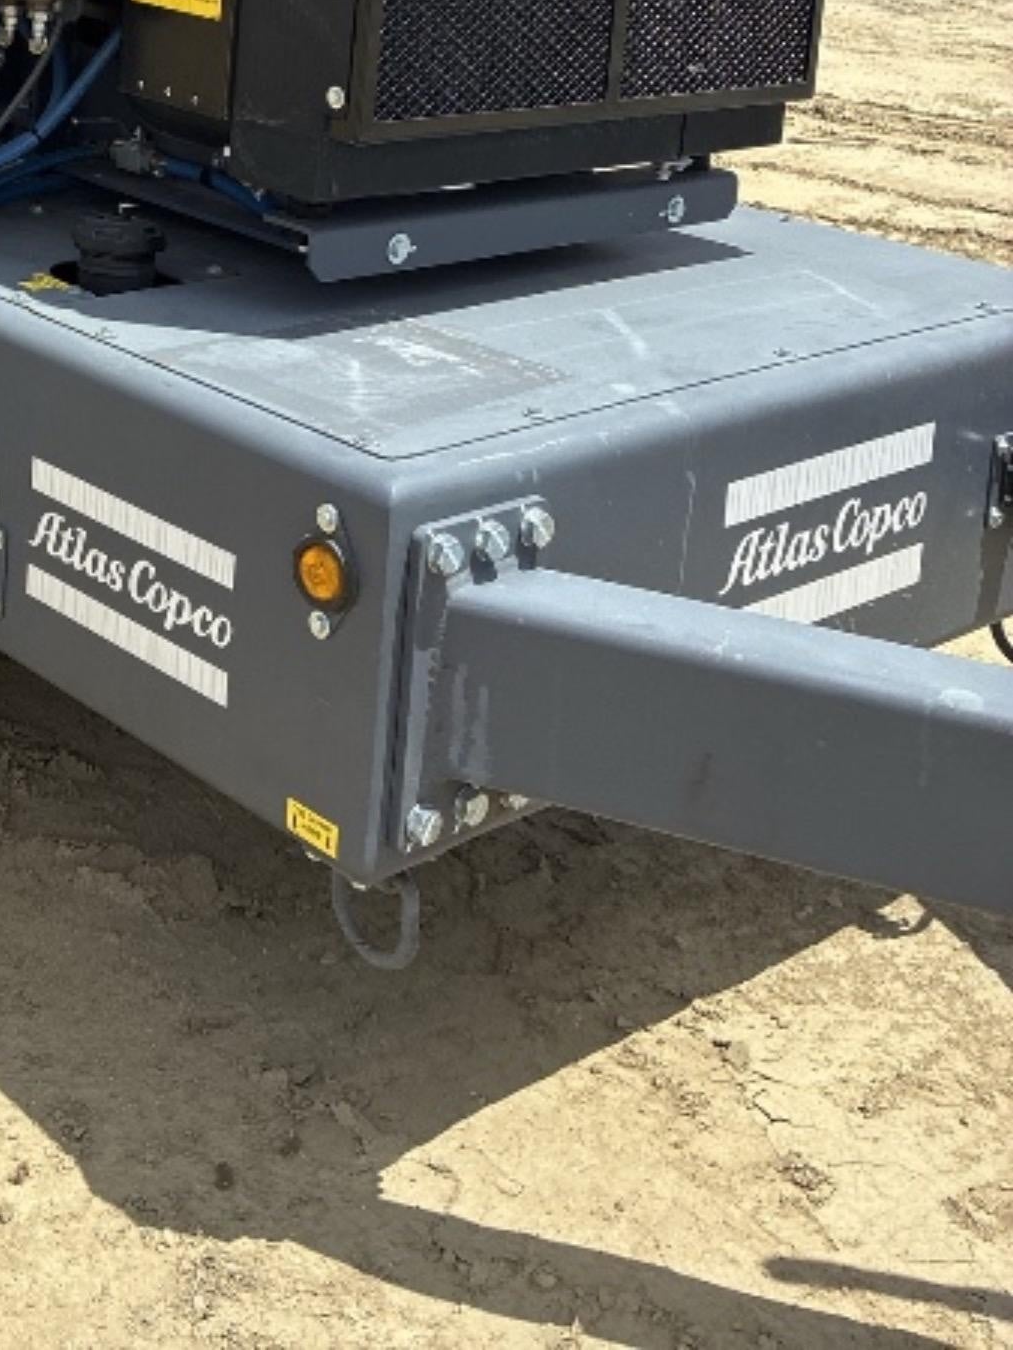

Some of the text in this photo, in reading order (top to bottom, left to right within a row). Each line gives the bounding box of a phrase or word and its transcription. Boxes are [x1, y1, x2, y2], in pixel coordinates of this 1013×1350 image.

[27, 511, 233, 649] Atlas Copco
[717, 490, 928, 597] Atlas Copco
